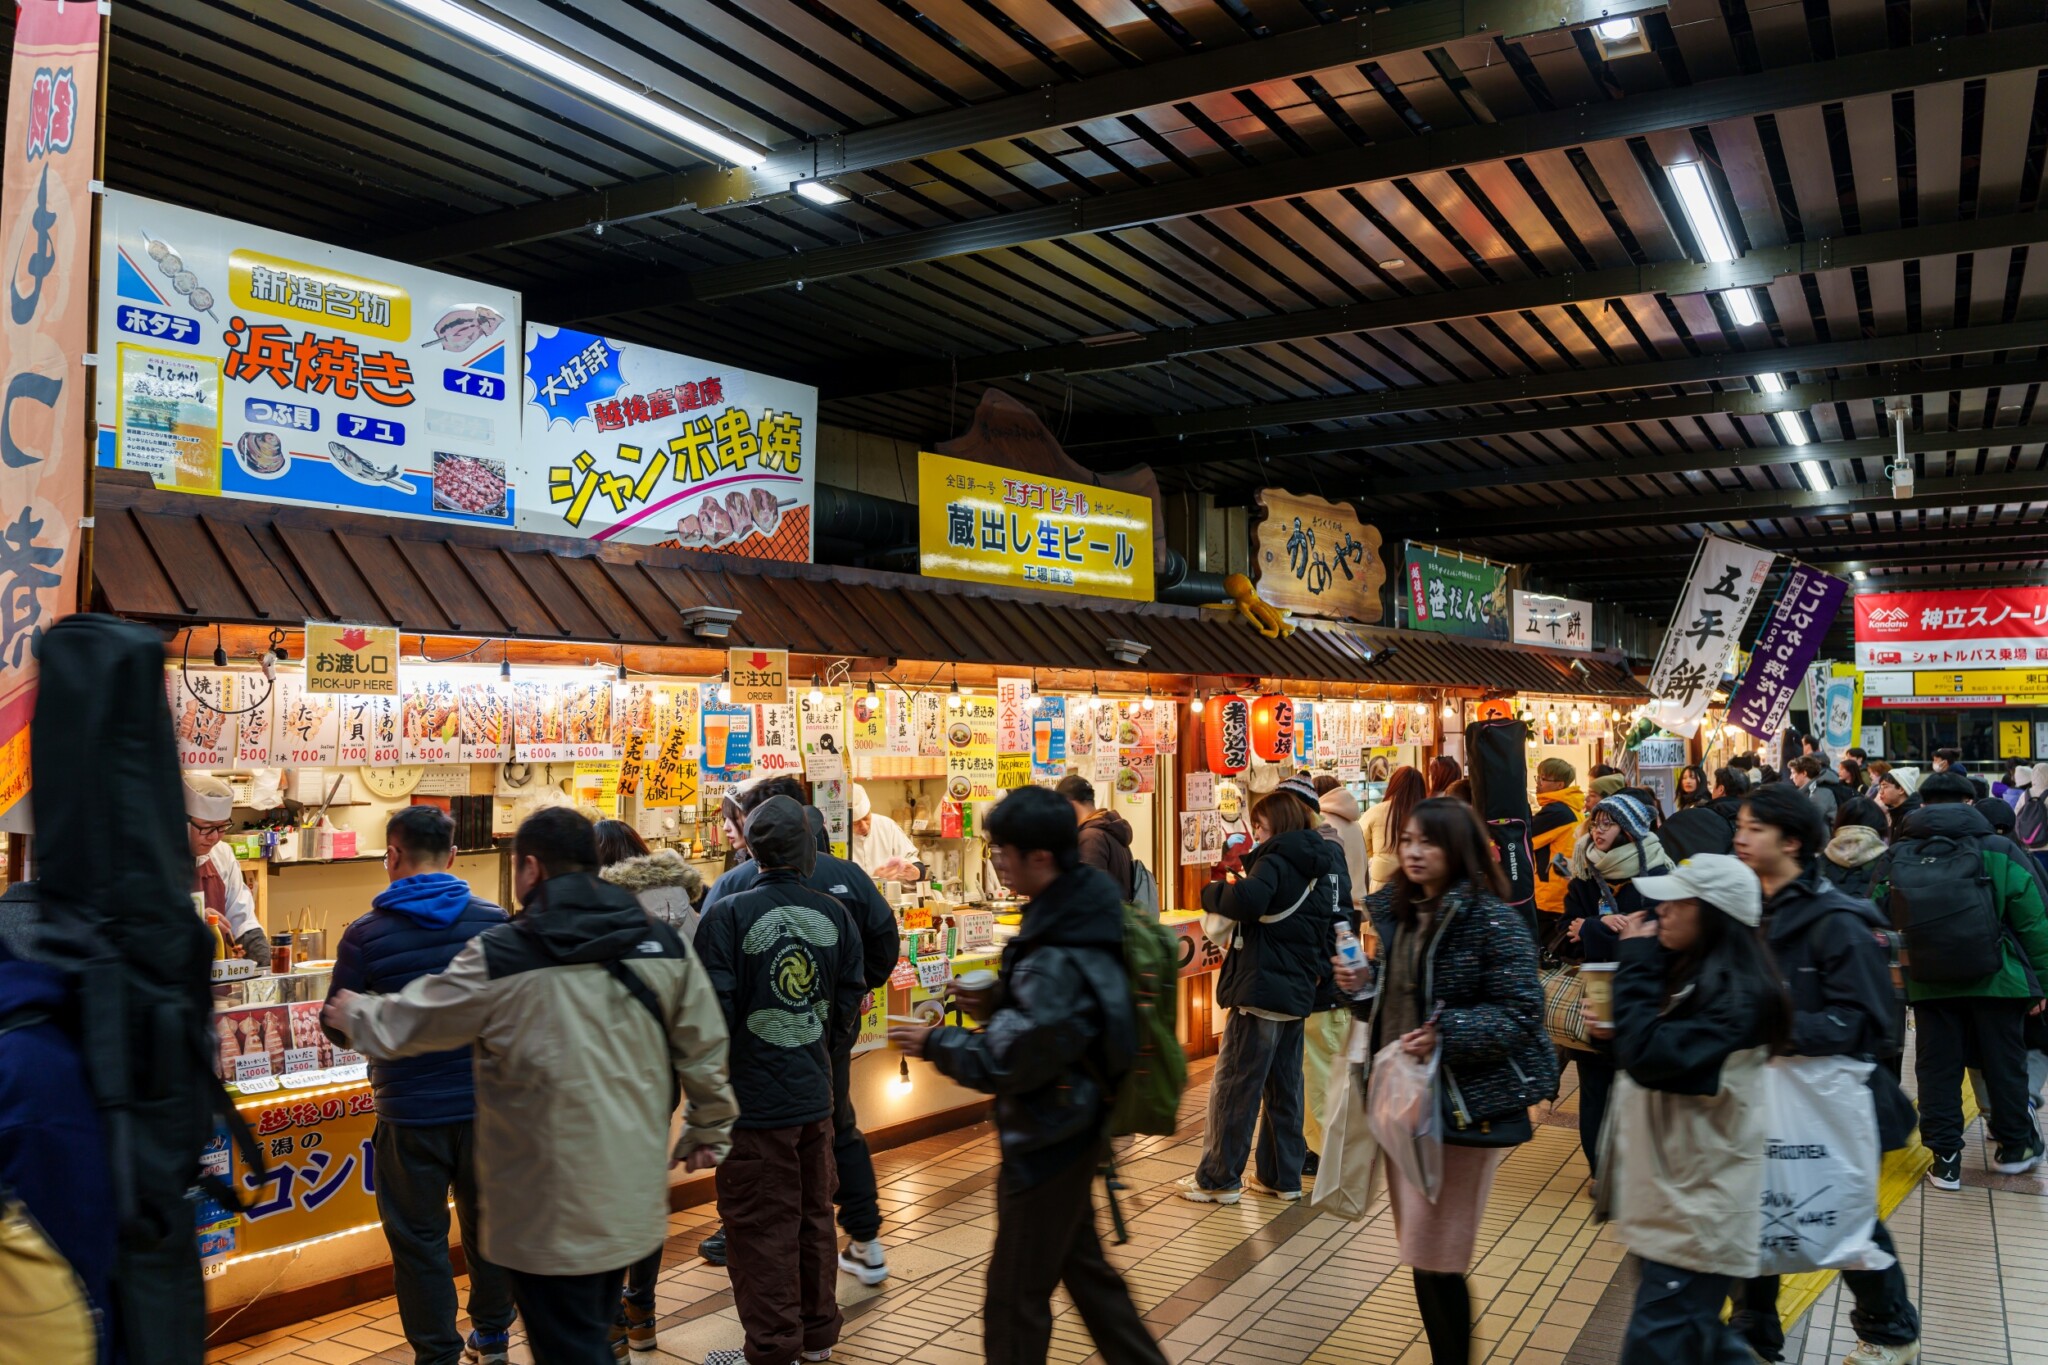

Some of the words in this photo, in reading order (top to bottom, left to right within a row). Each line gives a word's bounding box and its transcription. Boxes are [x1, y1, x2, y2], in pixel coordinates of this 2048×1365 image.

[250, 265, 391, 328] 新潟名物
[124, 309, 193, 341] ホタテ
[223, 315, 416, 407] 浜焼き
[540, 339, 610, 407] 大好評
[455, 373, 495, 397] イカ
[250, 400, 314, 431] つぶ貝
[594, 376, 725, 434] 越後産健康
[348, 416, 397, 442] アユ
[548, 405, 802, 529] ジャンボ串焼
[945, 473, 996, 496] 全国第一号
[946, 503, 1135, 570] 蔵出し生ビール
[1023, 564, 1075, 586] 工場直送
[1410, 565, 1427, 616] 越後名物
[1526, 608, 1582, 641] 五平餅
[1662, 565, 1742, 708] 五平餅
[1868, 619, 1909, 630] Kandatsu
[1701, 587, 1758, 697] 新潟産コシヒカリのみ使用
[1913, 648, 2027, 663] シャトルバス乗場
[316, 653, 388, 674] お渡し口
[733, 670, 782, 687] ご注文口
[2026, 674, 2048, 684] 東口
[311, 678, 361, 689] PICK-UP
[363, 679, 393, 690] HERE
[747, 691, 773, 701] ORDER
[194, 675, 213, 746] 焼きいか
[249, 676, 264, 744] いいだこ
[425, 682, 436, 743] もろこし
[486, 683, 497, 718] 粗挽き
[535, 684, 544, 742] とりもも串
[588, 684, 598, 721] 牛タン
[631, 685, 639, 727] 牛ハラミ
[675, 693, 683, 727] もち
[351, 694, 368, 742] ブ貝
[382, 697, 394, 743] きあゆ
[480, 705, 488, 744] フランク
[579, 709, 588, 742] つくね
[898, 697, 907, 737] 長者盛
[1000, 684, 1017, 749] 現金のみ
[1274, 702, 1292, 754] たこ焼
[1223, 701, 1248, 768] 煮込み
[275, 754, 288, 762] 1本
[405, 751, 416, 759] 1本
[652, 727, 686, 790] 完売御札
[950, 758, 994, 770] 牛すじ煮込み
[998, 760, 1009, 771] This
[1010, 759, 1024, 771] place
[1119, 755, 1154, 766] もつ煮
[371, 770, 376, 778] 8
[378, 779, 384, 787] 7
[389, 781, 394, 789] 6
[400, 778, 405, 786] 5
[407, 769, 412, 777] 4
[997, 772, 1015, 788] CASH
[1015, 771, 1031, 786] ONLY
[645, 787, 668, 801] 右側
[1510, 852, 1518, 881] nature
[228, 966, 250, 977] here
[770, 943, 803, 975] EXPLORATION
[287, 1052, 313, 1061] いいだこ
[240, 1078, 277, 1092] Squid
[204, 1262, 224, 1276] eer
